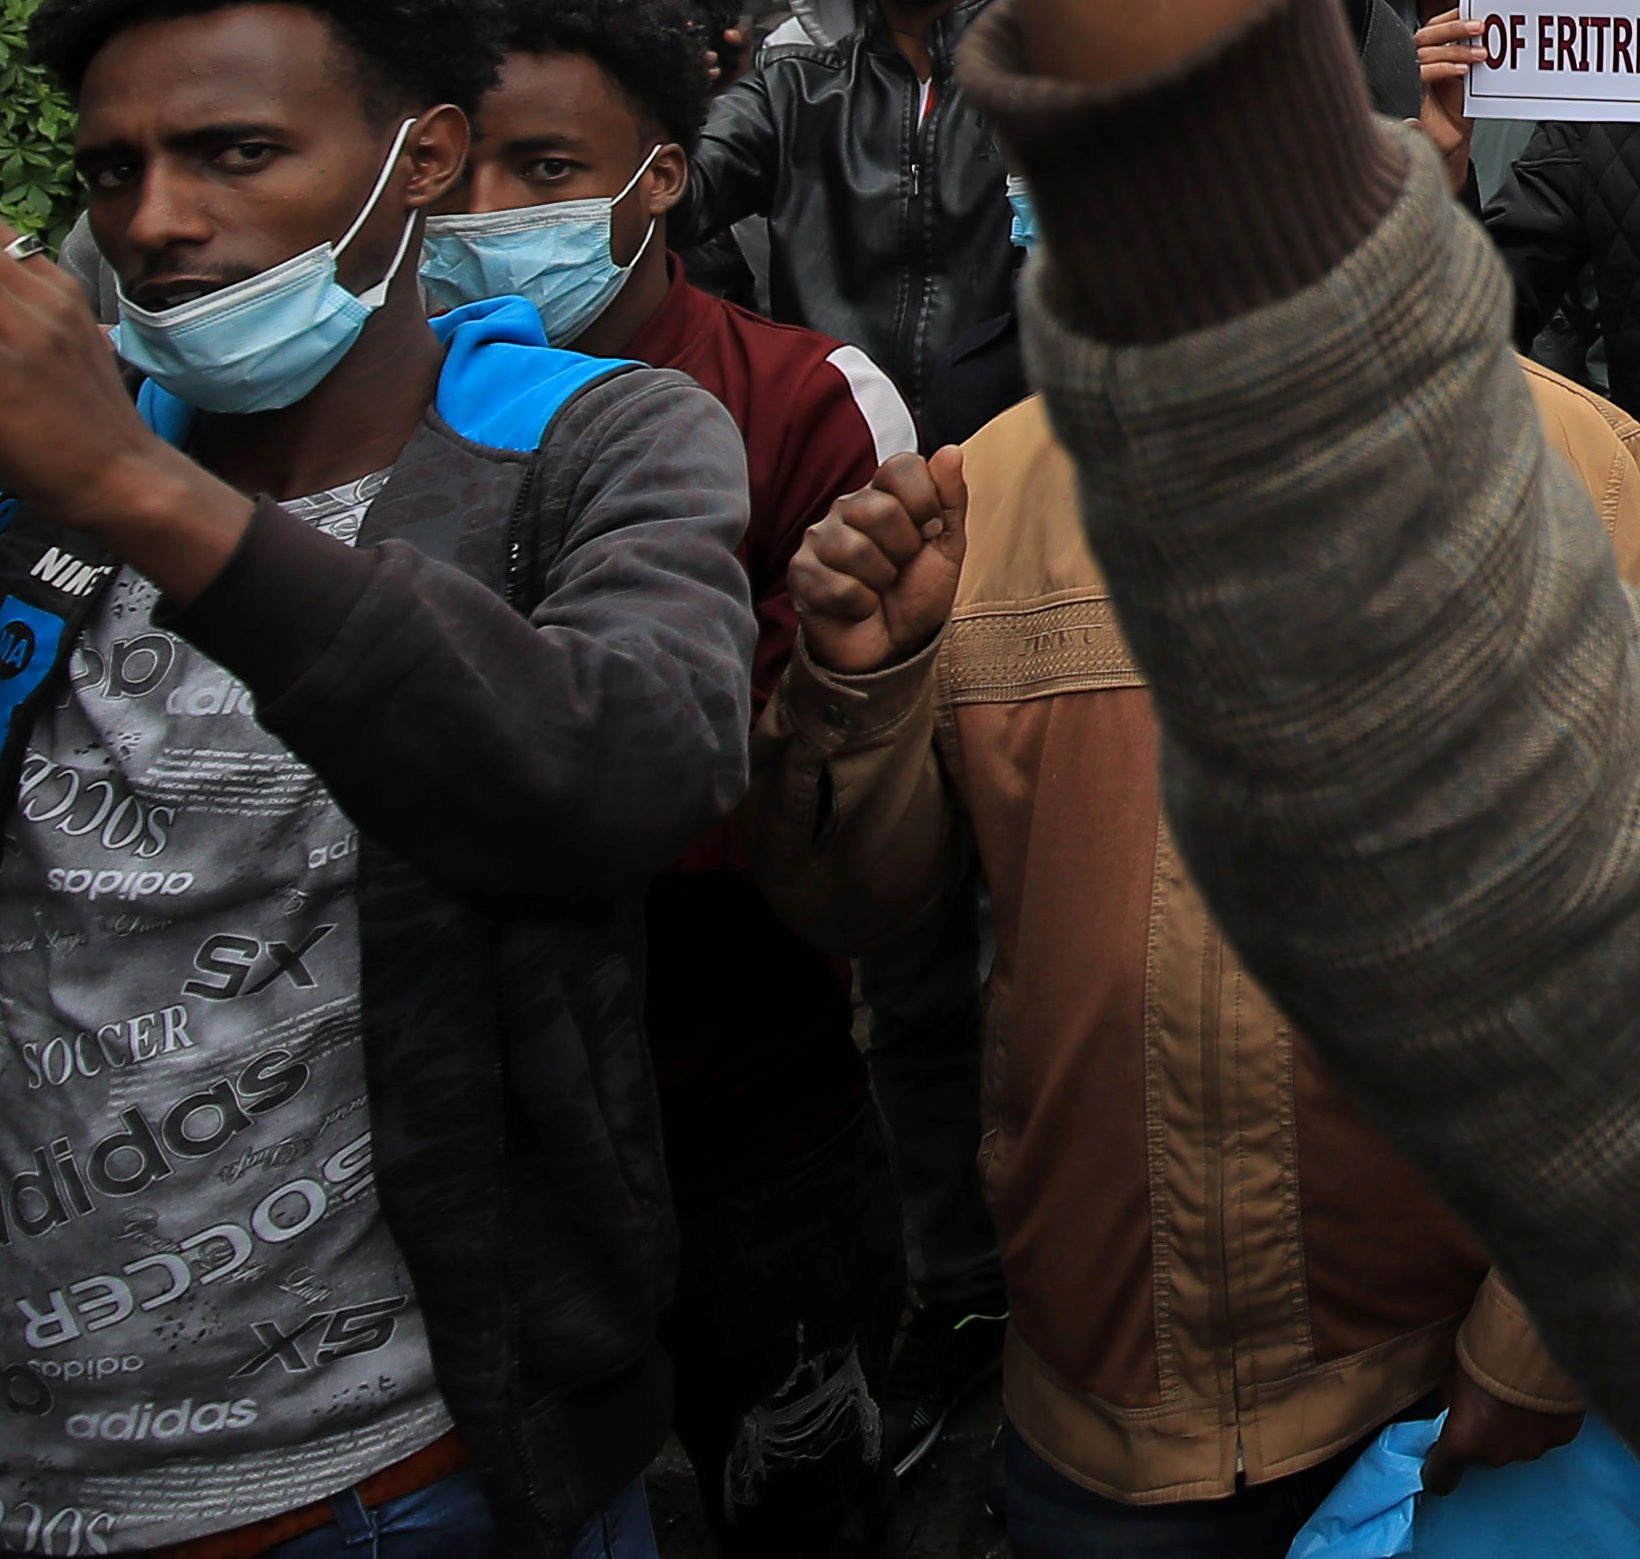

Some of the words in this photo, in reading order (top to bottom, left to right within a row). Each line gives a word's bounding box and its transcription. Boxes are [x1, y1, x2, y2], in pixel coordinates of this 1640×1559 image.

[1484, 13, 1527, 71] OF
[23, 1004, 194, 1090] SOCCER
[0, 1048, 310, 1246] didas
[65, 1397, 260, 1442] adidas
